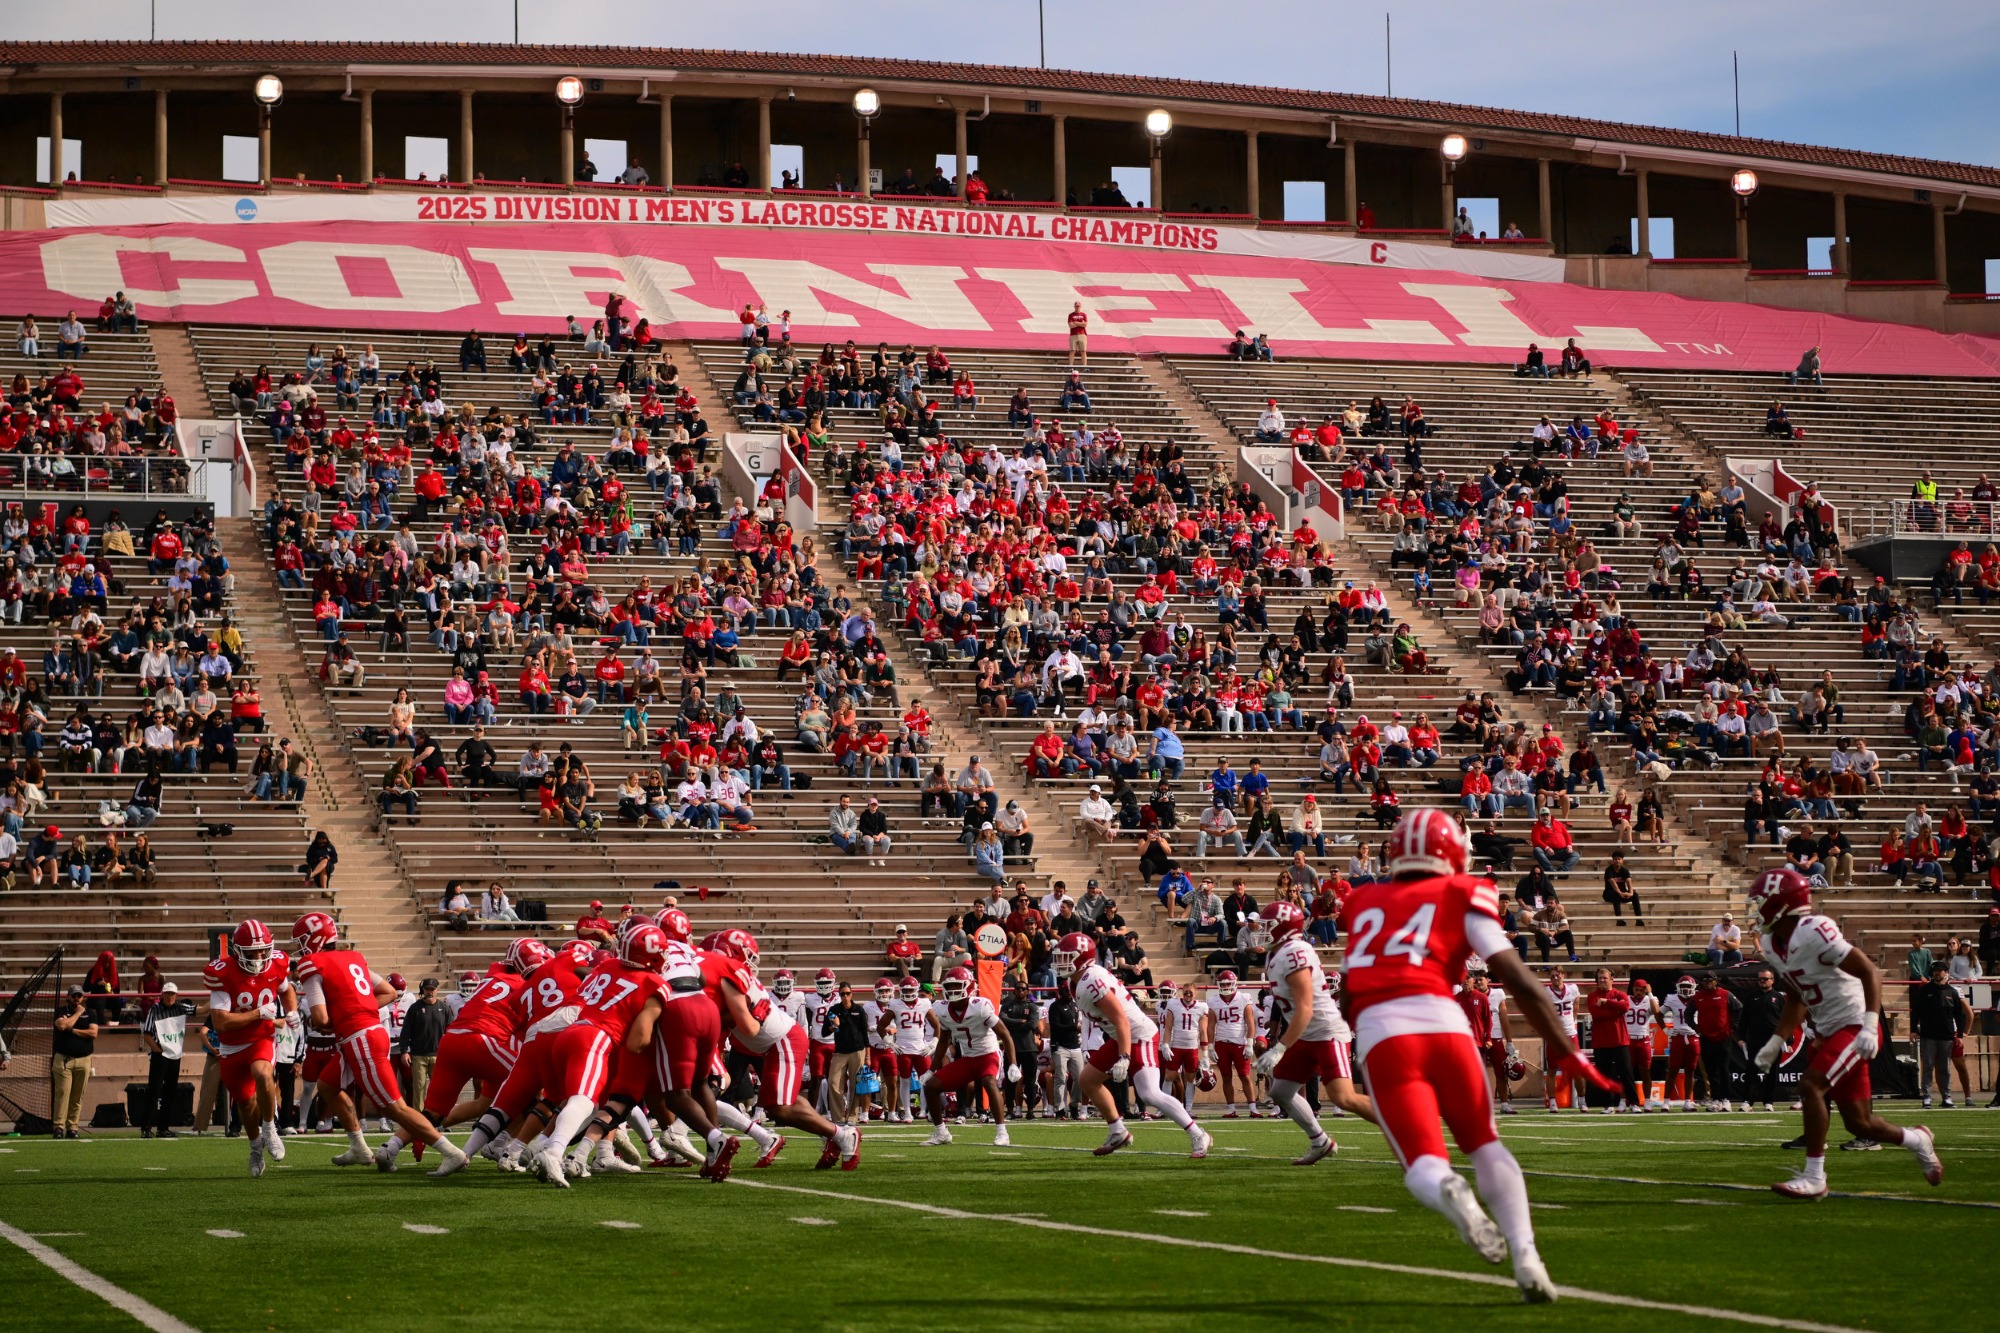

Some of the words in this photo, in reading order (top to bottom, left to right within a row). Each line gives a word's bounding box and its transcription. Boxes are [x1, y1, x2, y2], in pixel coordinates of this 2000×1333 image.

[417, 196, 487, 220] 2025
[494, 197, 620, 221] DIVISION
[628, 198, 638, 221] I
[645, 199, 734, 224] MEN'S
[740, 201, 888, 229] LACROSSE
[895, 207, 1044, 239] NATIONAL
[1051, 217, 1218, 250] CHAMPIONS
[1371, 242, 1387, 264] C
[39, 232, 1666, 353] CORNELL
[1665, 340, 1734, 356] TM
[202, 439, 212, 454] F
[748, 455, 761, 469] G
[721, 787, 735, 800] 36
[1763, 873, 1784, 895] H
[1276, 904, 1293, 922] H
[305, 915, 323, 933] C
[675, 915, 689, 934] C
[1814, 921, 1839, 944] 15
[644, 934, 660, 953] C
[728, 931, 746, 945] C
[986, 935, 1005, 945] TIAA
[1076, 936, 1088, 952] H
[1346, 903, 1437, 968] 24
[209, 958, 227, 971] 80
[1286, 949, 1307, 970] 35
[348, 963, 371, 996] 8
[1086, 978, 1107, 999] 34
[468, 977, 511, 1004] 72
[517, 977, 564, 1022] 78
[900, 1011, 923, 1029] 24
[1181, 1013, 1192, 1030] 11
[1218, 1006, 1240, 1024] 45
[957, 1027, 973, 1048] 7
